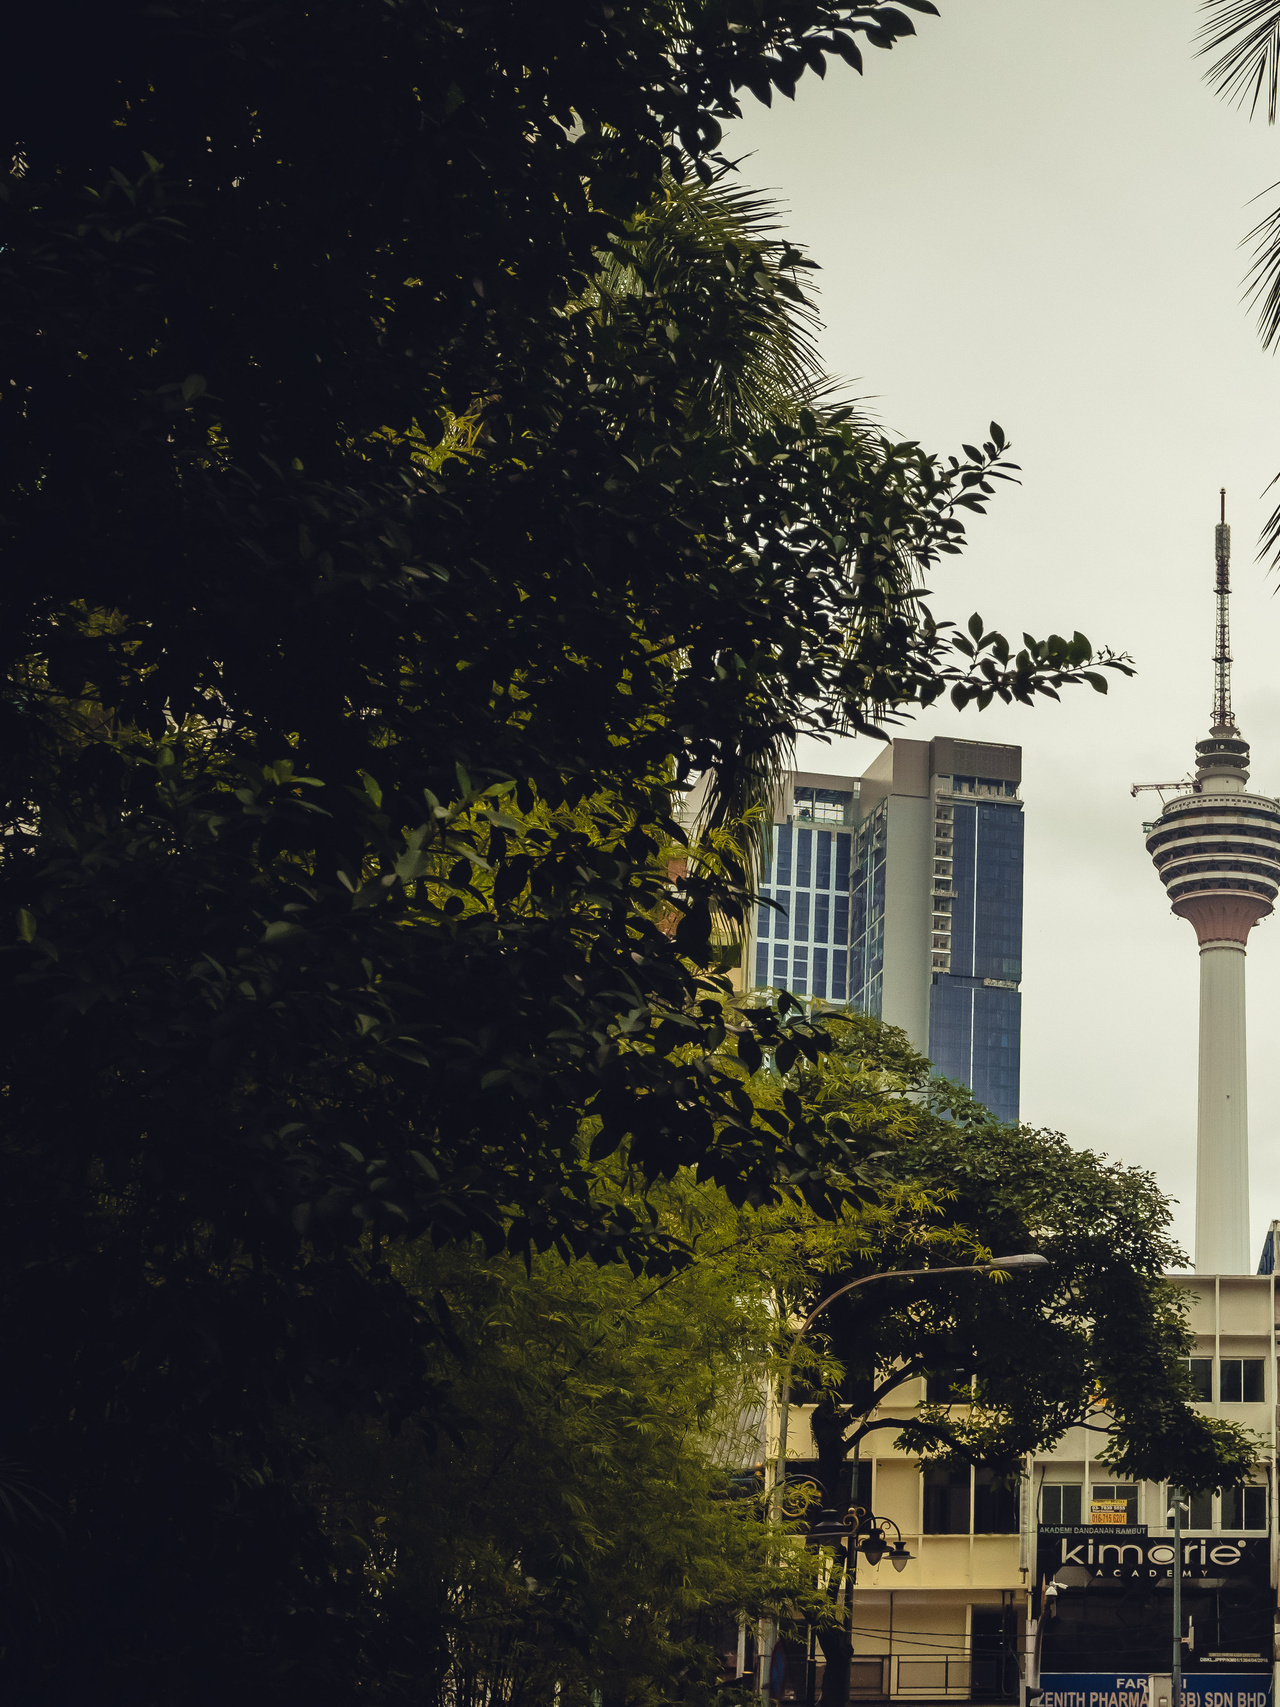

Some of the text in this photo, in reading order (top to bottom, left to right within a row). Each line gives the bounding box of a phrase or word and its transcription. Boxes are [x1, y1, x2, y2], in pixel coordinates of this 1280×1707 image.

[1039, 1526, 1147, 1535] AKADEMI DANDANAN RAMBUT
[1061, 1537, 1242, 1566] kimorie
[1095, 1569, 1209, 1578] ACADEMY
[1204, 1692, 1234, 1707] SDN
[1237, 1692, 1268, 1707] BHD
